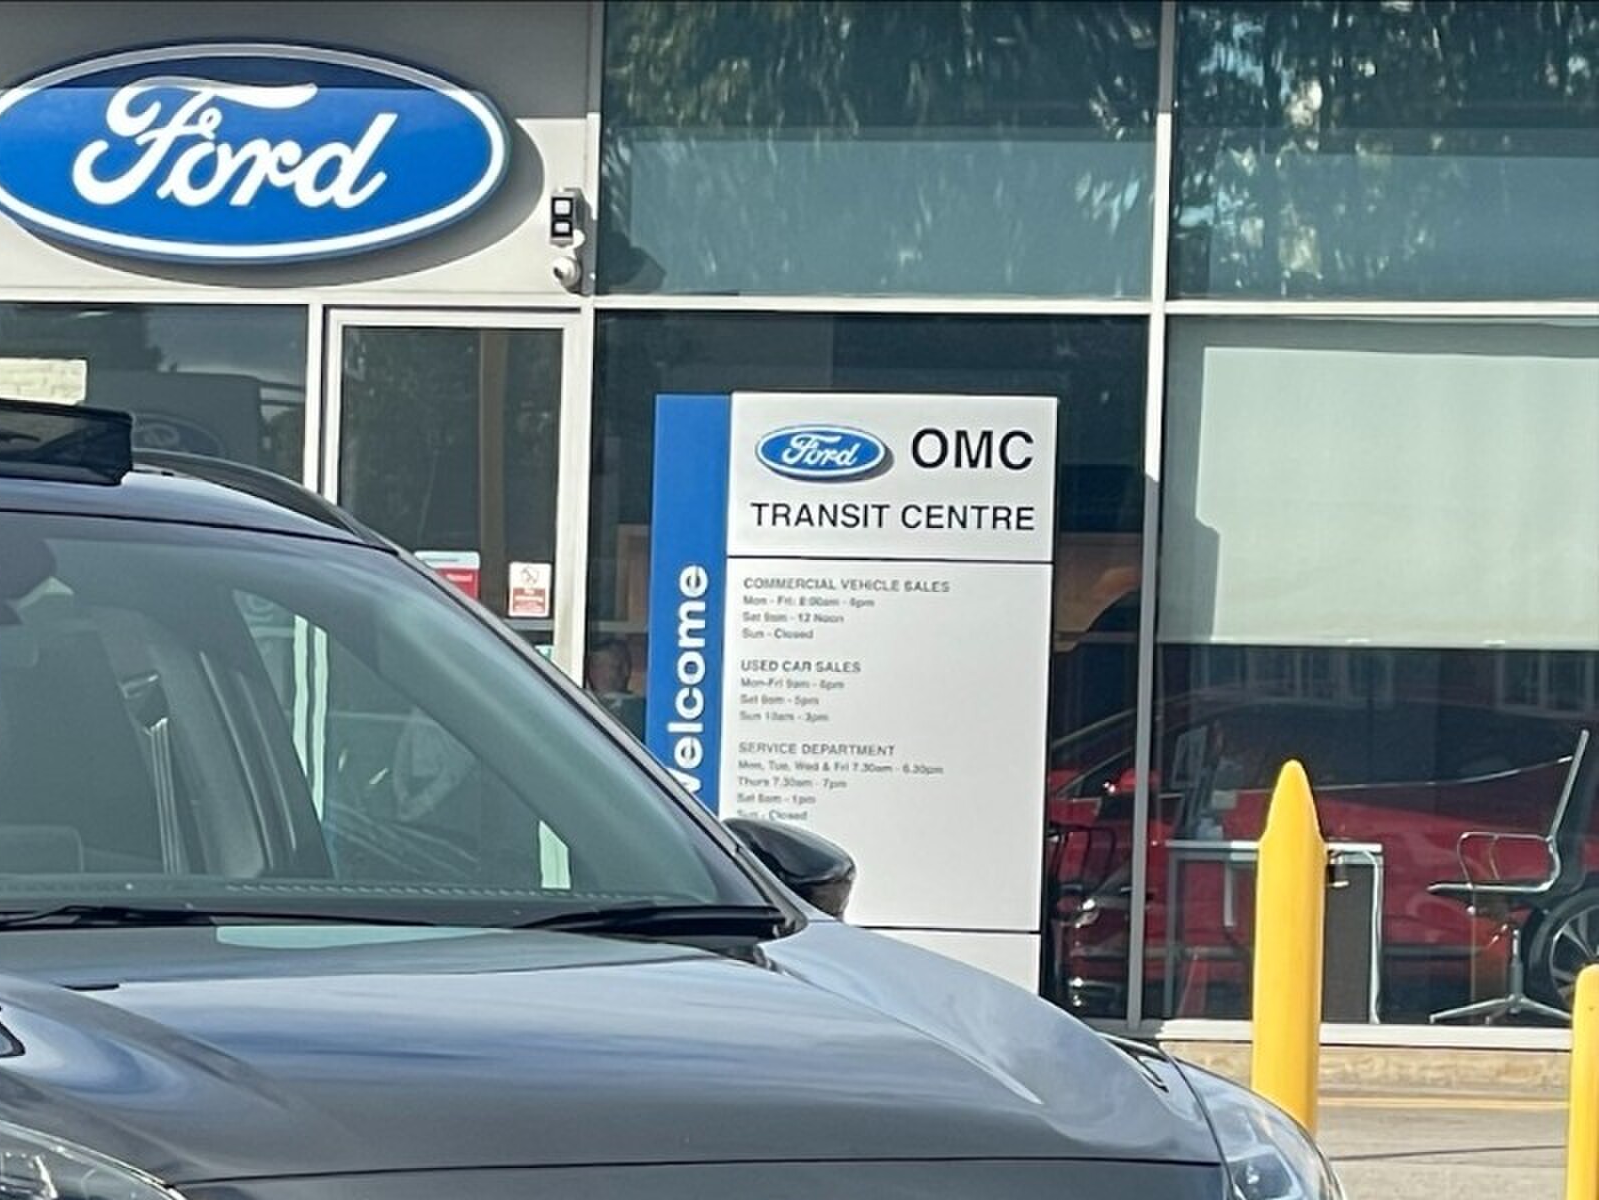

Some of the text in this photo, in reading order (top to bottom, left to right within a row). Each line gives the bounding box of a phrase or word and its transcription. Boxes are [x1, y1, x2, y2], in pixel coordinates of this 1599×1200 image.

[72, 76, 398, 209] Ford
[782, 427, 1035, 471] Ford OMC
[751, 503, 1035, 531] TRANSIT CENTRE
[743, 577, 950, 593] COMMERCIAL VEHICLE SALES
[743, 595, 767, 606] Mon
[742, 611, 761, 622] Sat
[813, 613, 844, 624] Noon
[742, 628, 764, 639] Sun
[774, 628, 814, 639] Closed
[741, 660, 861, 673] USED CAR SALES
[738, 742, 895, 757] SERVICE DEPARTMENT
